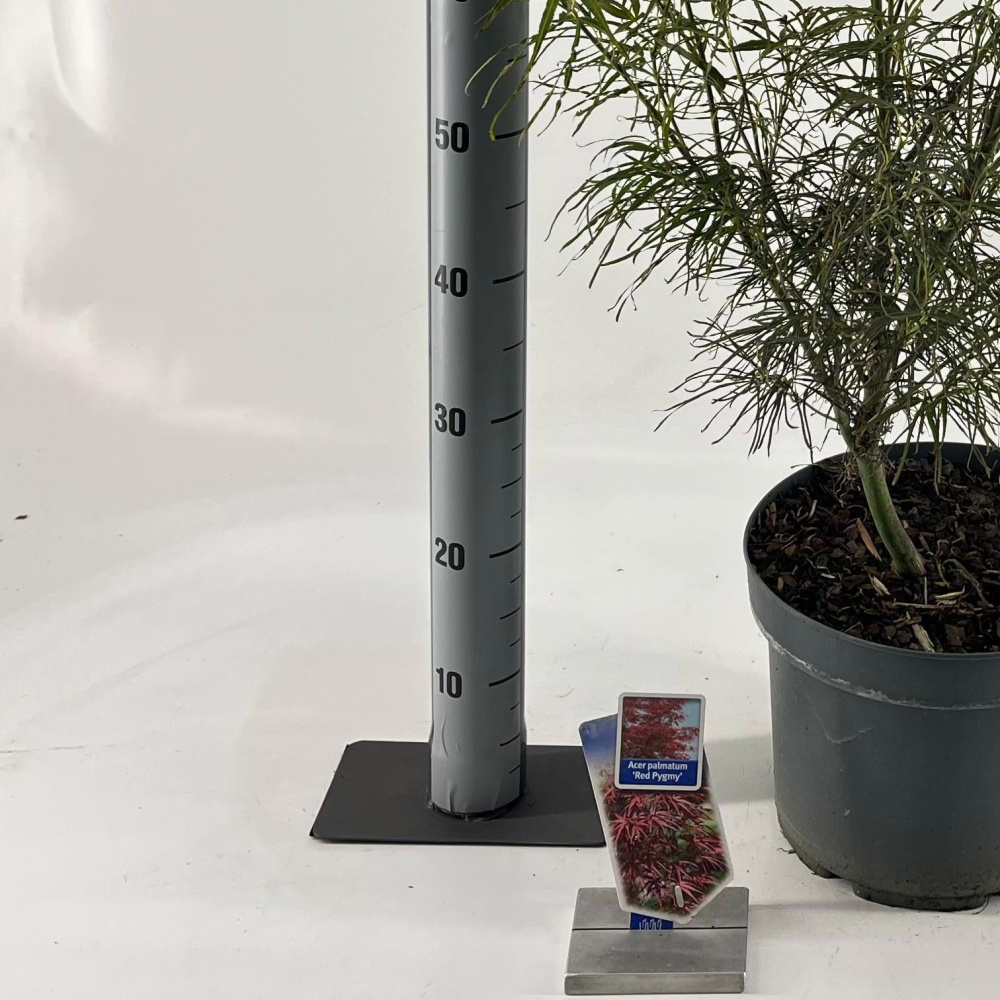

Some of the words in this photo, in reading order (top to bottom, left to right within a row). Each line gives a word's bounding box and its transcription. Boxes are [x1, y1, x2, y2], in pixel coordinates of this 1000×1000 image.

[435, 118, 469, 153] 50
[434, 265, 468, 298] 40
[434, 403, 466, 436] 30
[435, 537, 466, 571] 20
[435, 667, 463, 698] 10
[627, 760, 646, 769] Acer
[647, 761, 688, 771] palmatum
